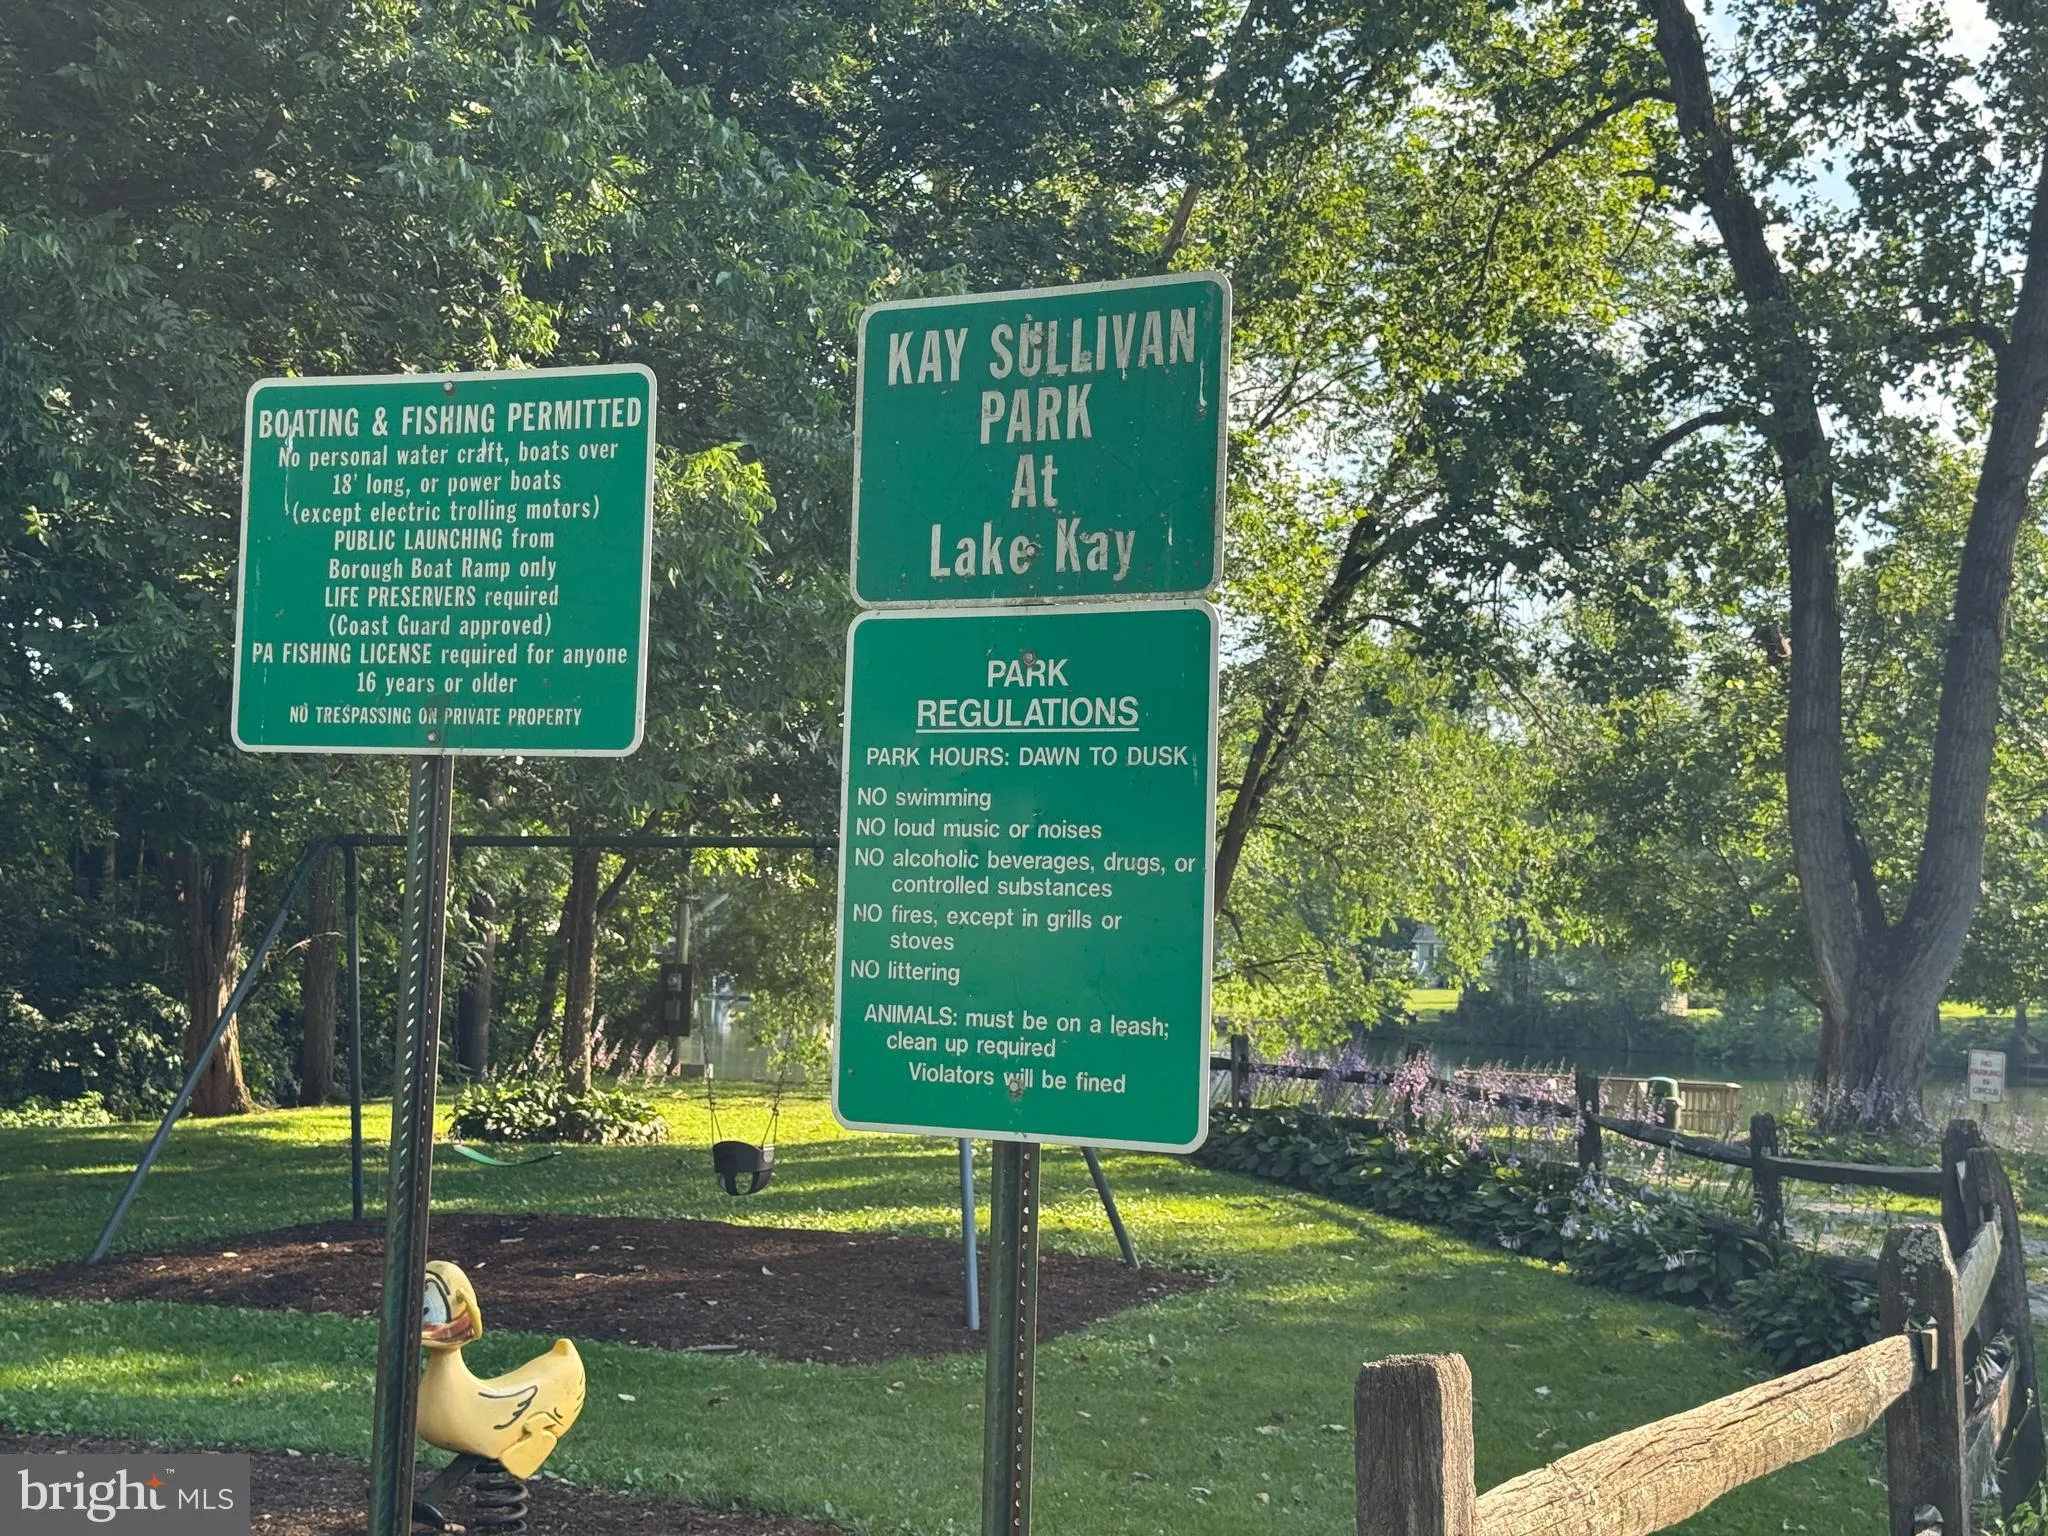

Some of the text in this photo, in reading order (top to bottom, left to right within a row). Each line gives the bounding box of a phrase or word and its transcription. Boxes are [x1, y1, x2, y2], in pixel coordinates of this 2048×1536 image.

[888, 307, 1196, 386] KAY SULLIVAN
[259, 397, 641, 439] BOATING & FISHING PERMITTED
[980, 384, 1092, 445] PARK
[278, 440, 618, 471] No personal water craft, boats over
[366, 473, 411, 498] long,
[420, 476, 439, 493] or
[448, 474, 502, 496] power
[511, 470, 561, 491] boats
[1011, 454, 1058, 509] At
[292, 496, 600, 526] (except electric trolling motors)
[334, 528, 554, 551] PUBLIC LAUNCHING from
[930, 518, 1136, 582] Lake Kay
[329, 557, 557, 583] Borough Boat Ramp only
[324, 584, 559, 609] LIFE PRESERVERS required
[329, 613, 552, 637] (Coast Guard approved)
[252, 643, 628, 668] PA FISHING LICENSE required for anyone
[357, 672, 518, 696] 16 years or older
[988, 659, 1069, 688] PARK
[289, 703, 582, 726] NO TRESPASSING ON PRIVATE PROPERTY
[917, 696, 1139, 727] REGULATIONS
[866, 746, 1188, 766] PARK HOURS: DAWN TO DUSK
[857, 788, 992, 811] NO swimming
[856, 818, 1102, 839] NO loud music or noises
[854, 848, 1195, 874] NO alcoholic beverages, drugs, or
[892, 875, 1112, 898] controlled substances
[853, 904, 1122, 932] NO fires, except in grills or
[890, 932, 954, 950] stoves
[850, 959, 960, 986] NO littering
[864, 1004, 1169, 1040] ANIMALS: must be on a leash;
[887, 1032, 1056, 1059] clean up required
[908, 1062, 1126, 1093] Violators will be fined
